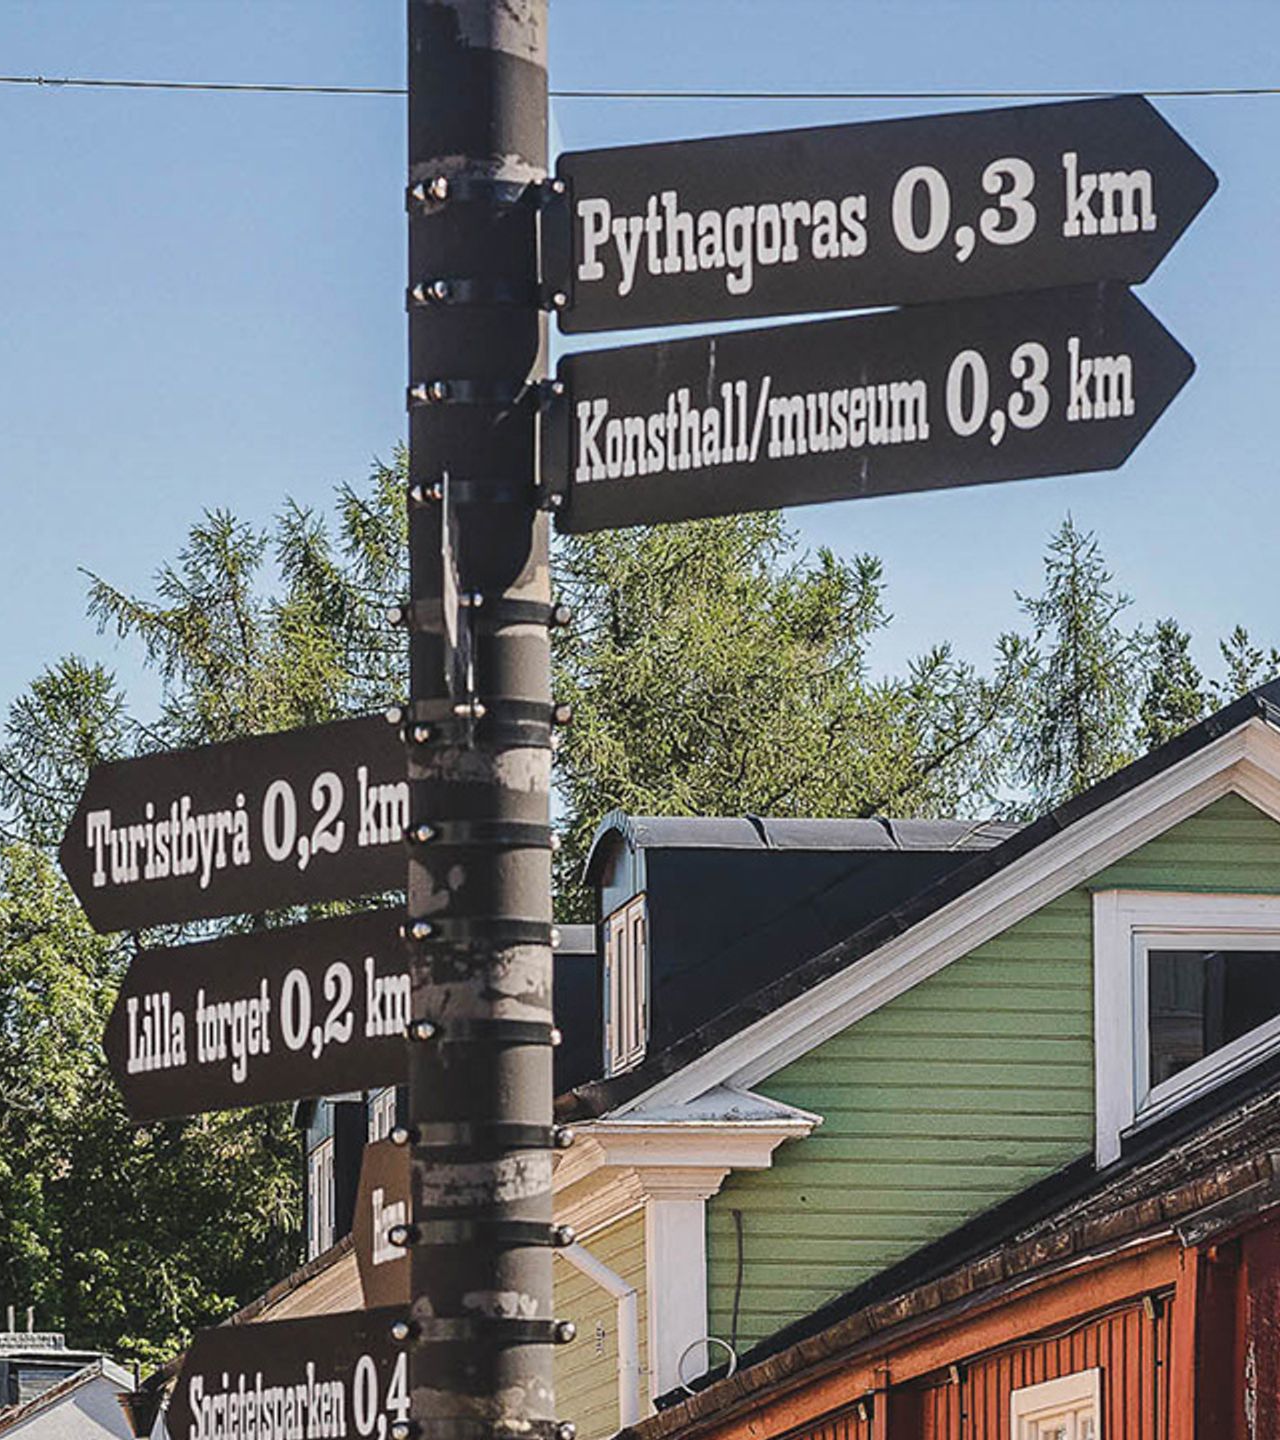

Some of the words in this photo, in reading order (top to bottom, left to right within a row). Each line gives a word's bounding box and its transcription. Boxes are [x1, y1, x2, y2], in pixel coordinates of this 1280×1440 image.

[577, 190, 868, 295] Pythagoras
[891, 158, 1037, 262] 0,3
[1061, 152, 1156, 238] km
[575, 376, 929, 483] Konsthall/museum
[946, 342, 1050, 445] 0,3
[1066, 337, 1135, 422] km
[87, 793, 250, 889] Turistbyrå
[263, 772, 344, 870] 0,2
[357, 766, 410, 846] km
[127, 991, 186, 1074] Lilla
[196, 978, 270, 1083] torget
[280, 962, 354, 1059] 0,2
[365, 957, 411, 1037] km
